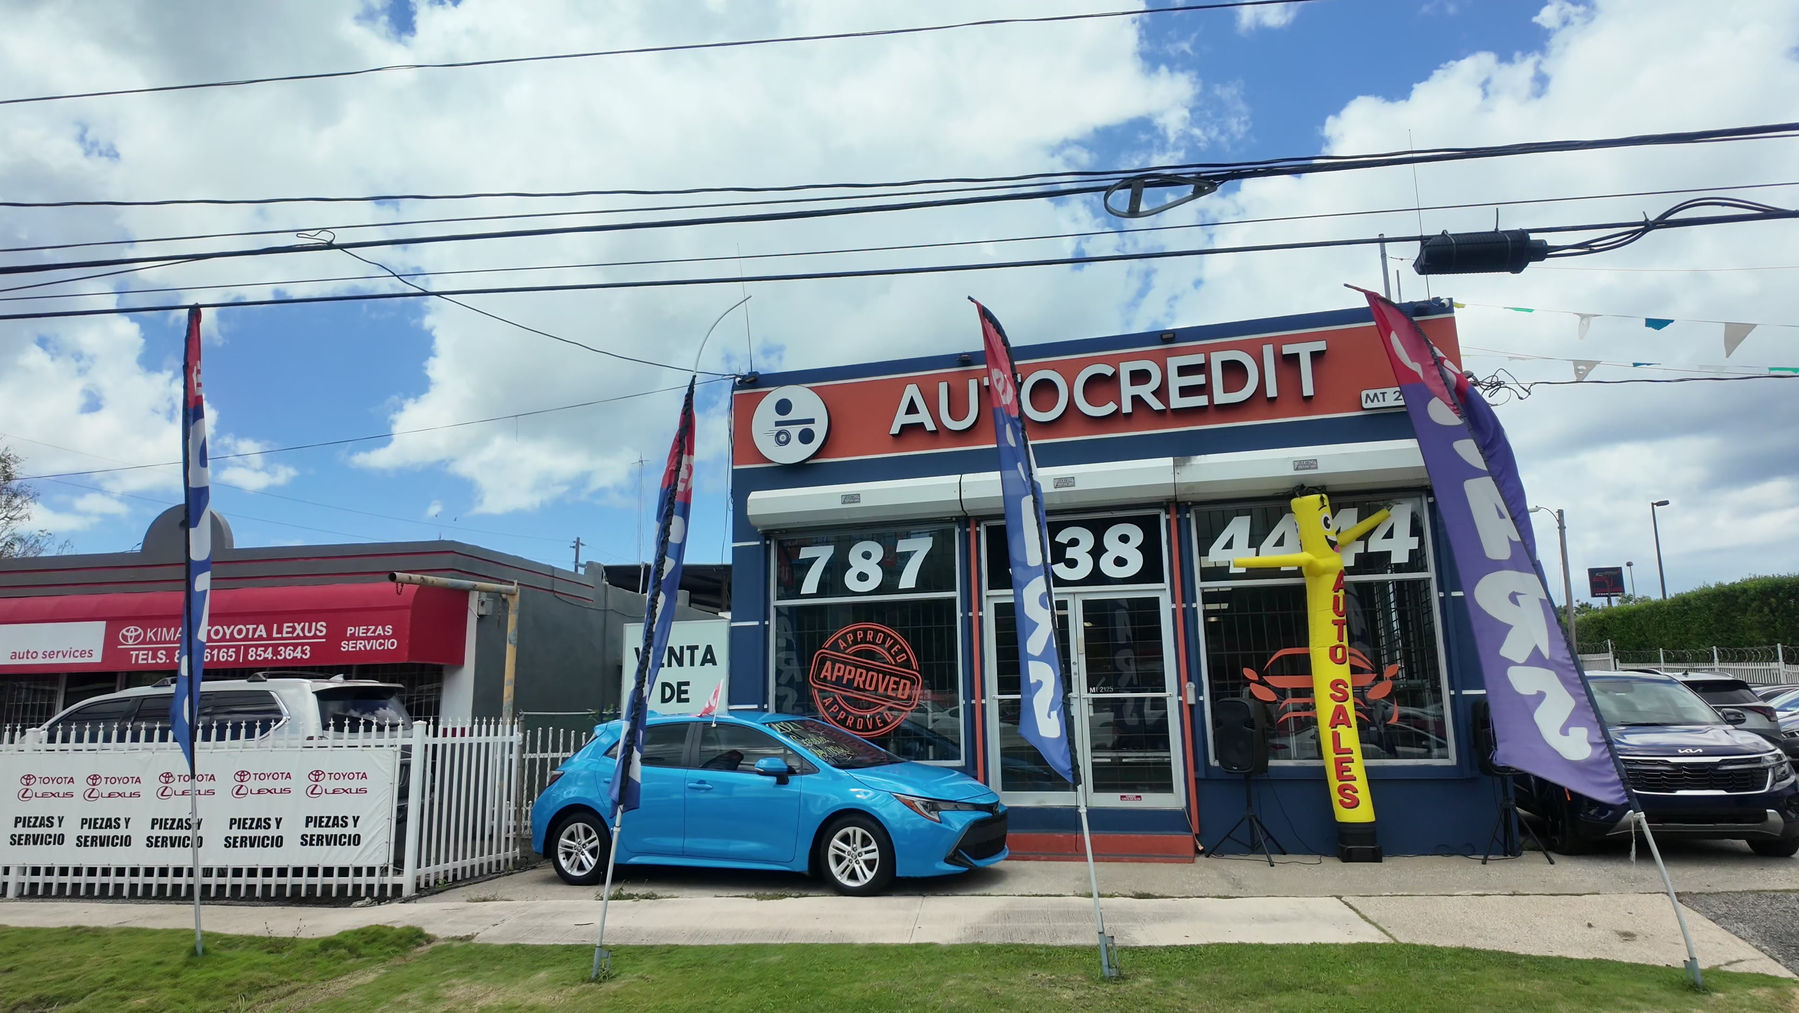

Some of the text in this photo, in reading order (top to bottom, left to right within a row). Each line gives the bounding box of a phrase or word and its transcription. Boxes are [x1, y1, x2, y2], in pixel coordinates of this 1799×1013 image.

[889, 340, 1327, 436] AUOCREDIT
[1364, 391, 1388, 405] MT
[799, 536, 934, 595] 787
[1009, 522, 1145, 581] 38
[272, 621, 327, 638] LEXUS
[346, 625, 393, 638] PIEZAS
[340, 638, 398, 652] SERVICIO
[837, 630, 908, 664] APPROVED
[10, 646, 94, 661] auto services
[130, 650, 171, 665] TELS.
[247, 645, 311, 662] 854.3643
[634, 644, 718, 668] NTA
[819, 660, 913, 700] APPROVED
[660, 681, 691, 704] DE
[1329, 568, 1360, 810] AUTO SALES
[823, 696, 895, 730] APPROVED
[37, 776, 75, 785] TOYOTA
[104, 776, 142, 785] TOYOTA
[177, 773, 216, 783] TOOTA
[253, 771, 292, 781] TOYOTA
[328, 771, 368, 781] TOYOTA
[34, 791, 74, 799] LEXUS
[100, 791, 141, 799] LEXUS
[250, 787, 292, 795] LEXUS
[325, 787, 368, 795] LEXUS
[13, 816, 65, 828] PIEZAS Y
[80, 817, 131, 830] PIEZAS Y
[150, 818, 192, 830] PIEZAS
[229, 817, 283, 830] PIEZAS Y
[305, 815, 361, 828] PIEZAS Y
[9, 833, 65, 846] SERVICIO
[75, 835, 132, 848] SERVICIO
[224, 835, 284, 848] SERVICIO
[300, 833, 362, 846] SERVICIO
